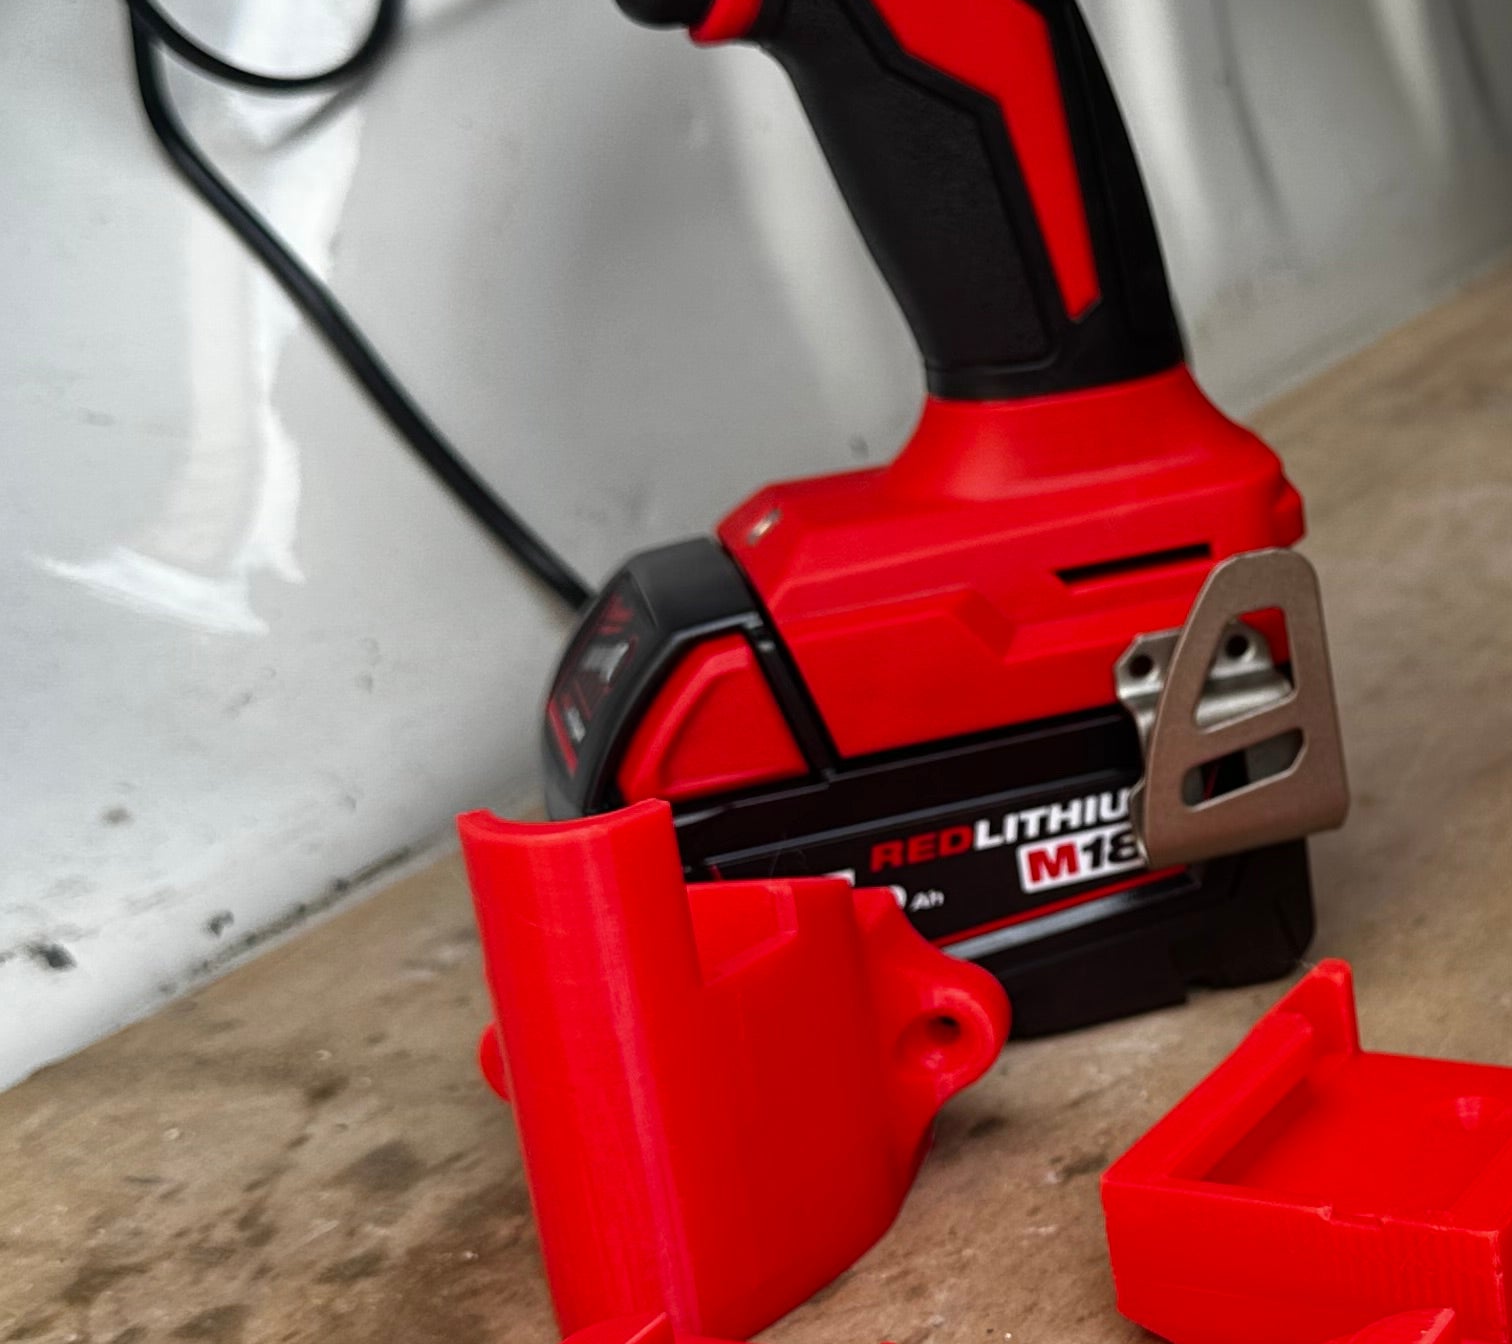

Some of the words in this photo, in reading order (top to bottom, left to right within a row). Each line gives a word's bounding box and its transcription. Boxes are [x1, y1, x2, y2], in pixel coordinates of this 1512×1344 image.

[870, 788, 1131, 873] REDLITHIU
[1027, 827, 1137, 884] M18
[911, 890, 944, 911] Ah
